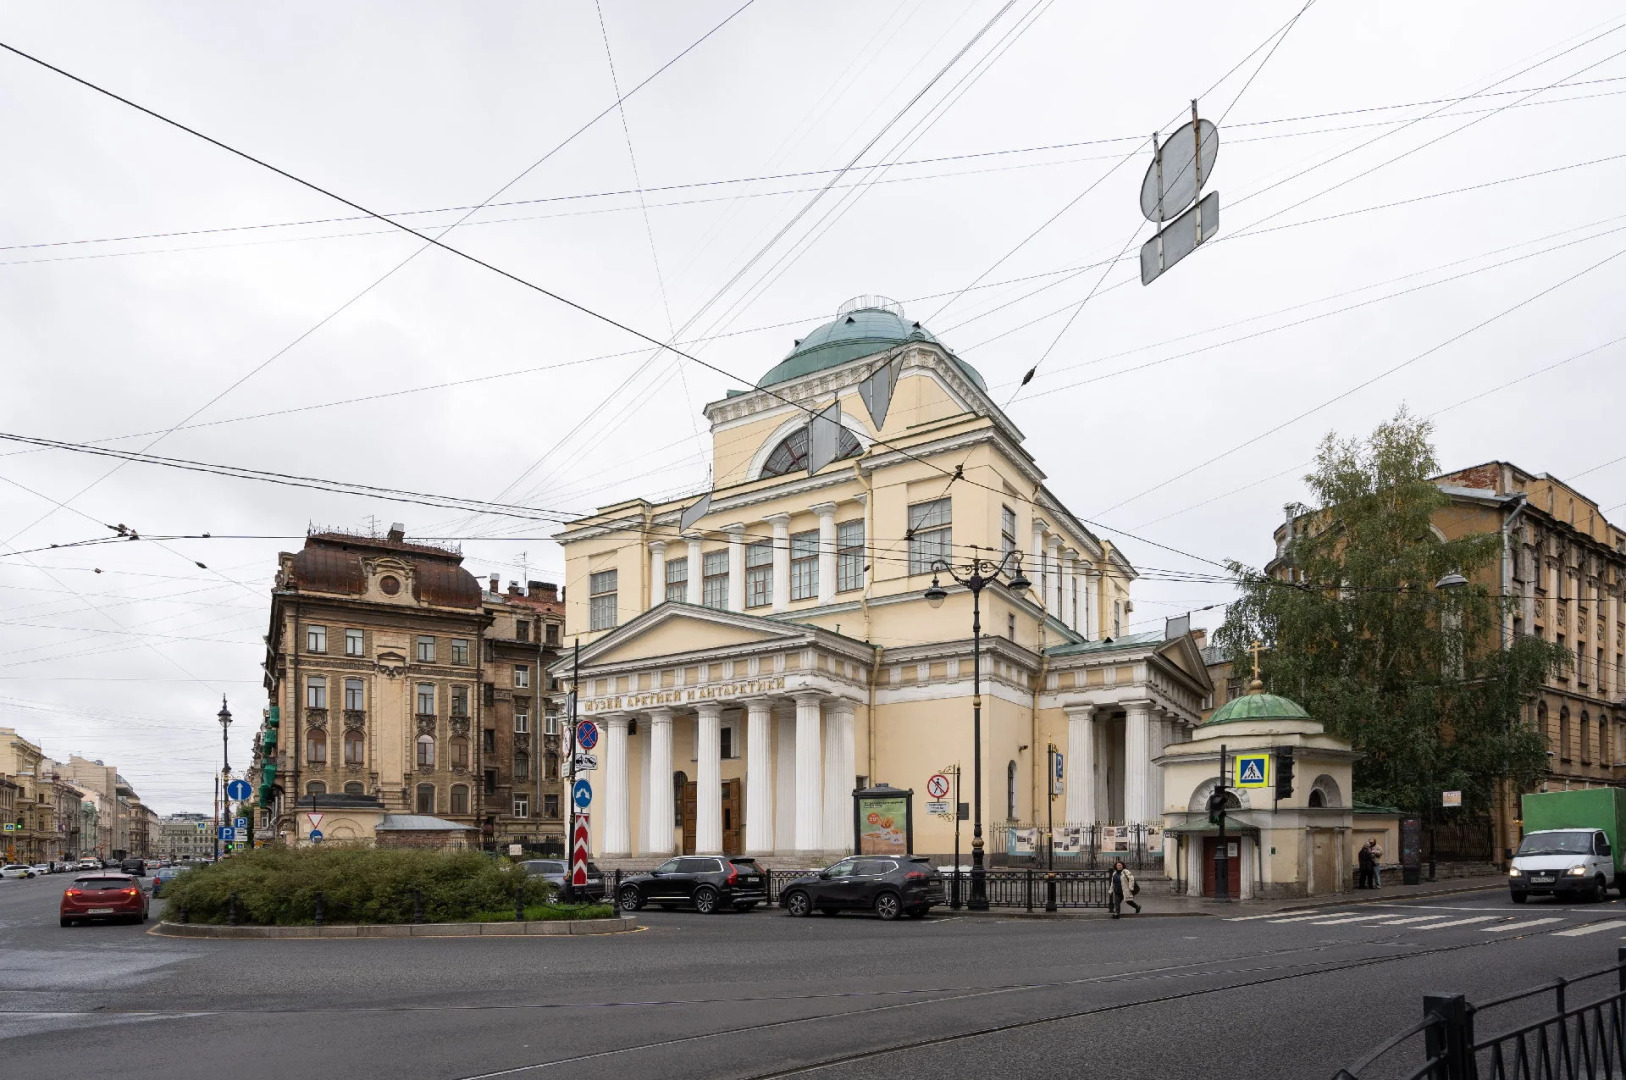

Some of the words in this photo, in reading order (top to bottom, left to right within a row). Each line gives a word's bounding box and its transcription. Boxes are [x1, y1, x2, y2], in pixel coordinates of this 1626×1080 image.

[584, 696, 622, 712] МУЗЕЙ
[627, 691, 681, 707] АРКТИКИ
[687, 690, 695, 700] И
[698, 677, 785, 699] АНТАРКТИКИ
[238, 818, 244, 828] P
[222, 828, 232, 838] P
